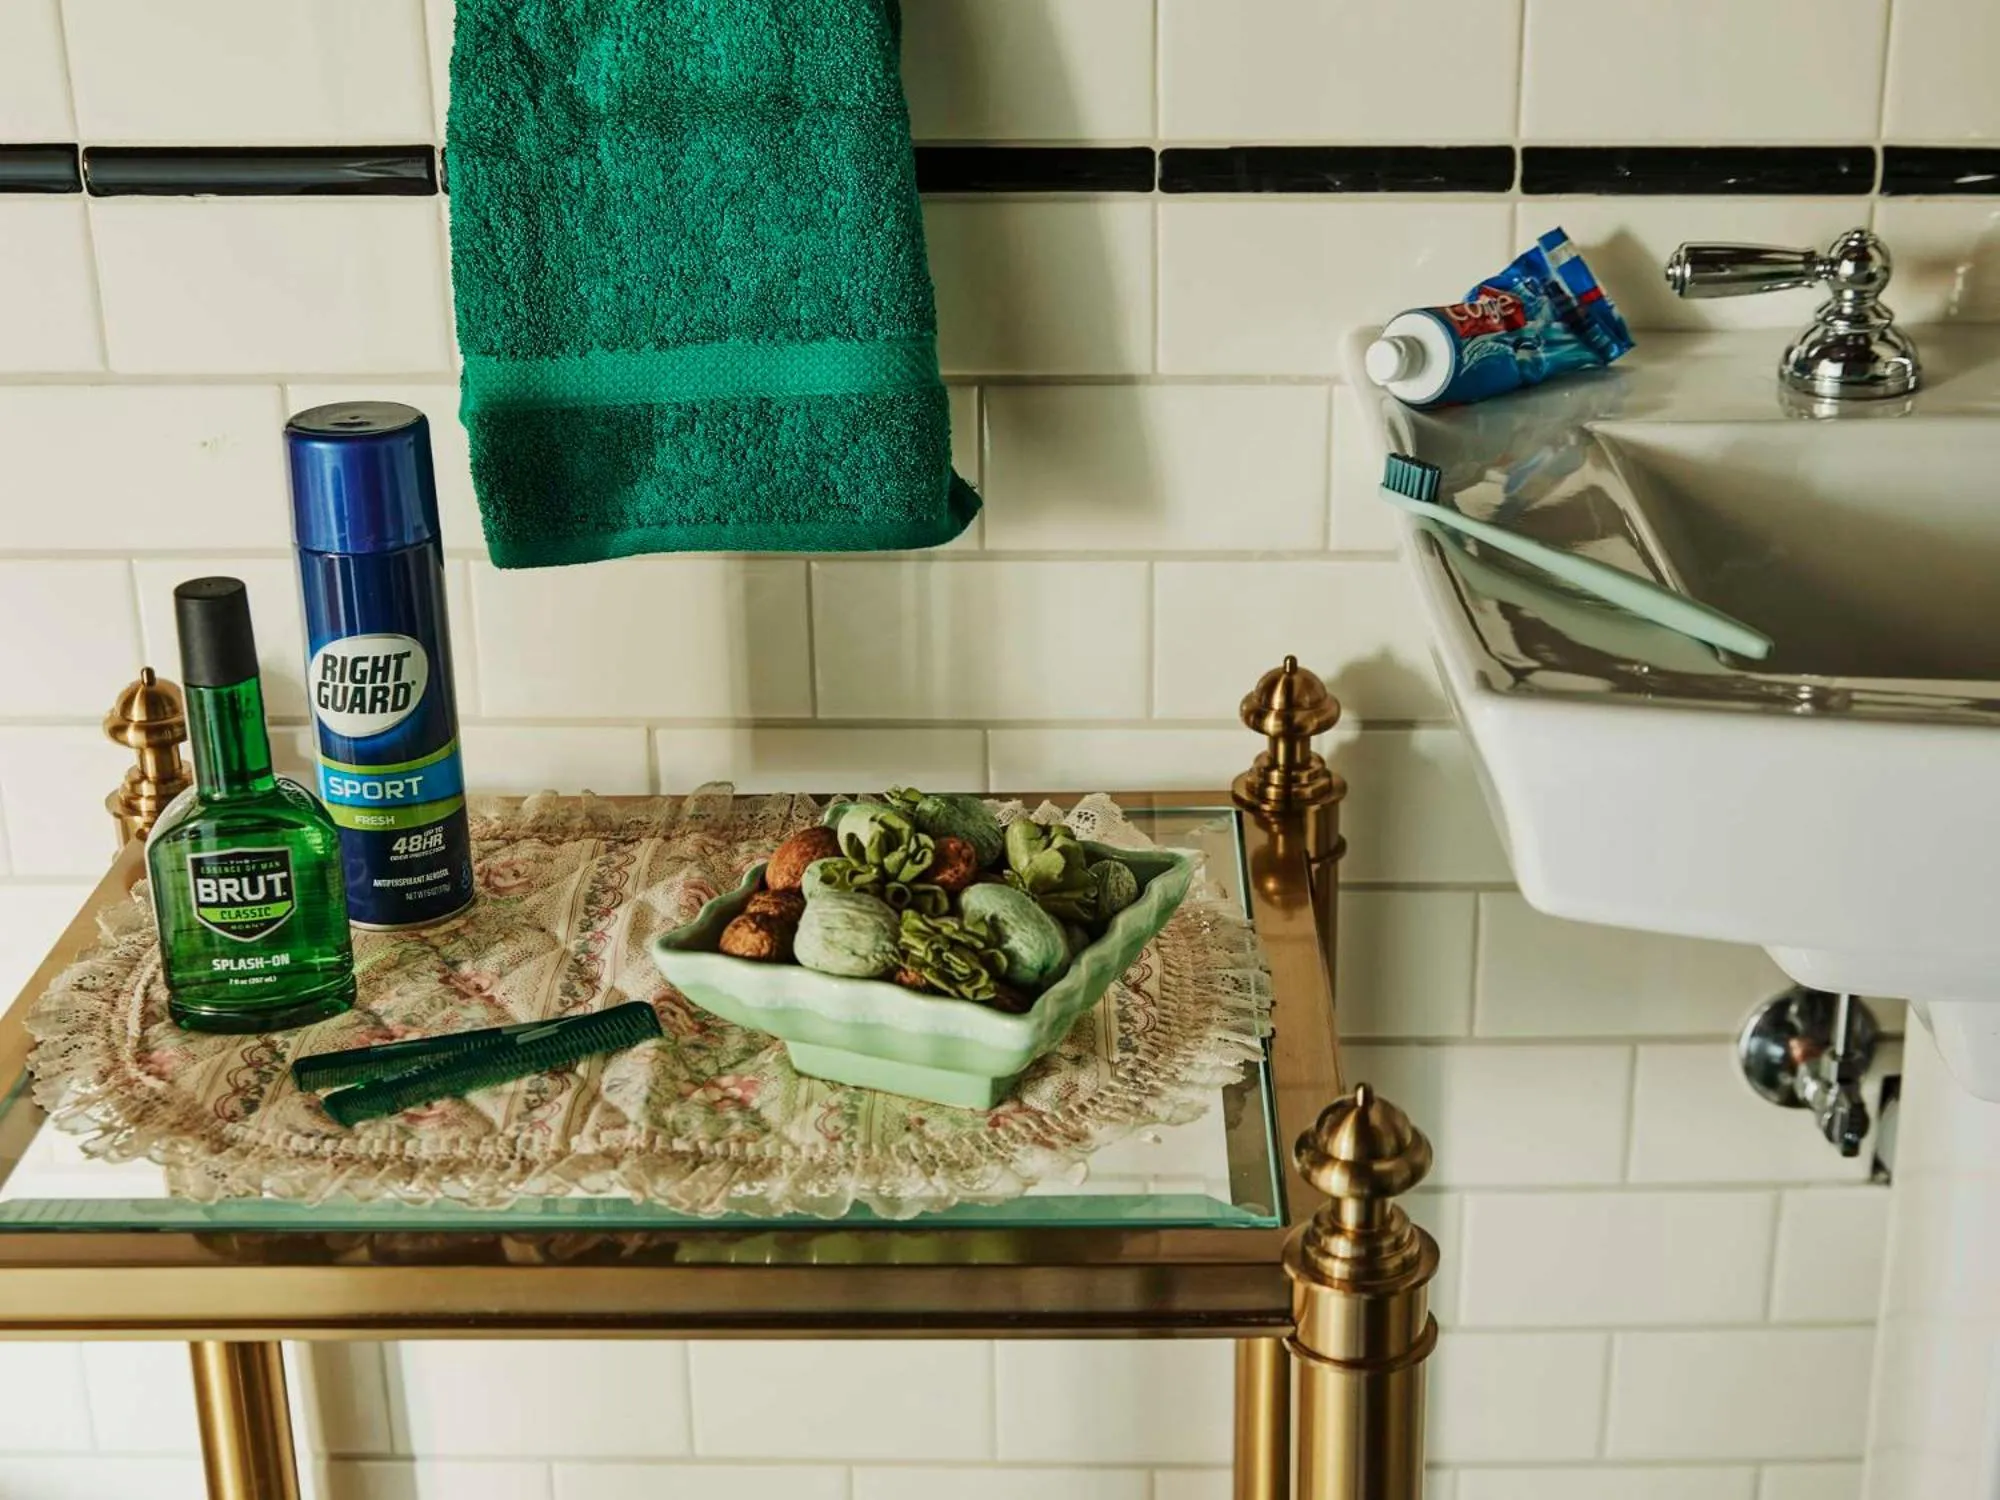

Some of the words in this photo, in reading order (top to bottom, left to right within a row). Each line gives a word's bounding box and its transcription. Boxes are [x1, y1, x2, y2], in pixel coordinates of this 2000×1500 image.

[322, 651, 412, 684] RIGHT
[317, 681, 412, 714] GUARD
[328, 775, 424, 800] SPORT
[354, 815, 396, 826] FRESH
[245, 864, 257, 872] OF
[196, 871, 289, 904] BRUT
[220, 906, 272, 920] CLASSIC
[212, 953, 290, 971] SPLASH-ON
